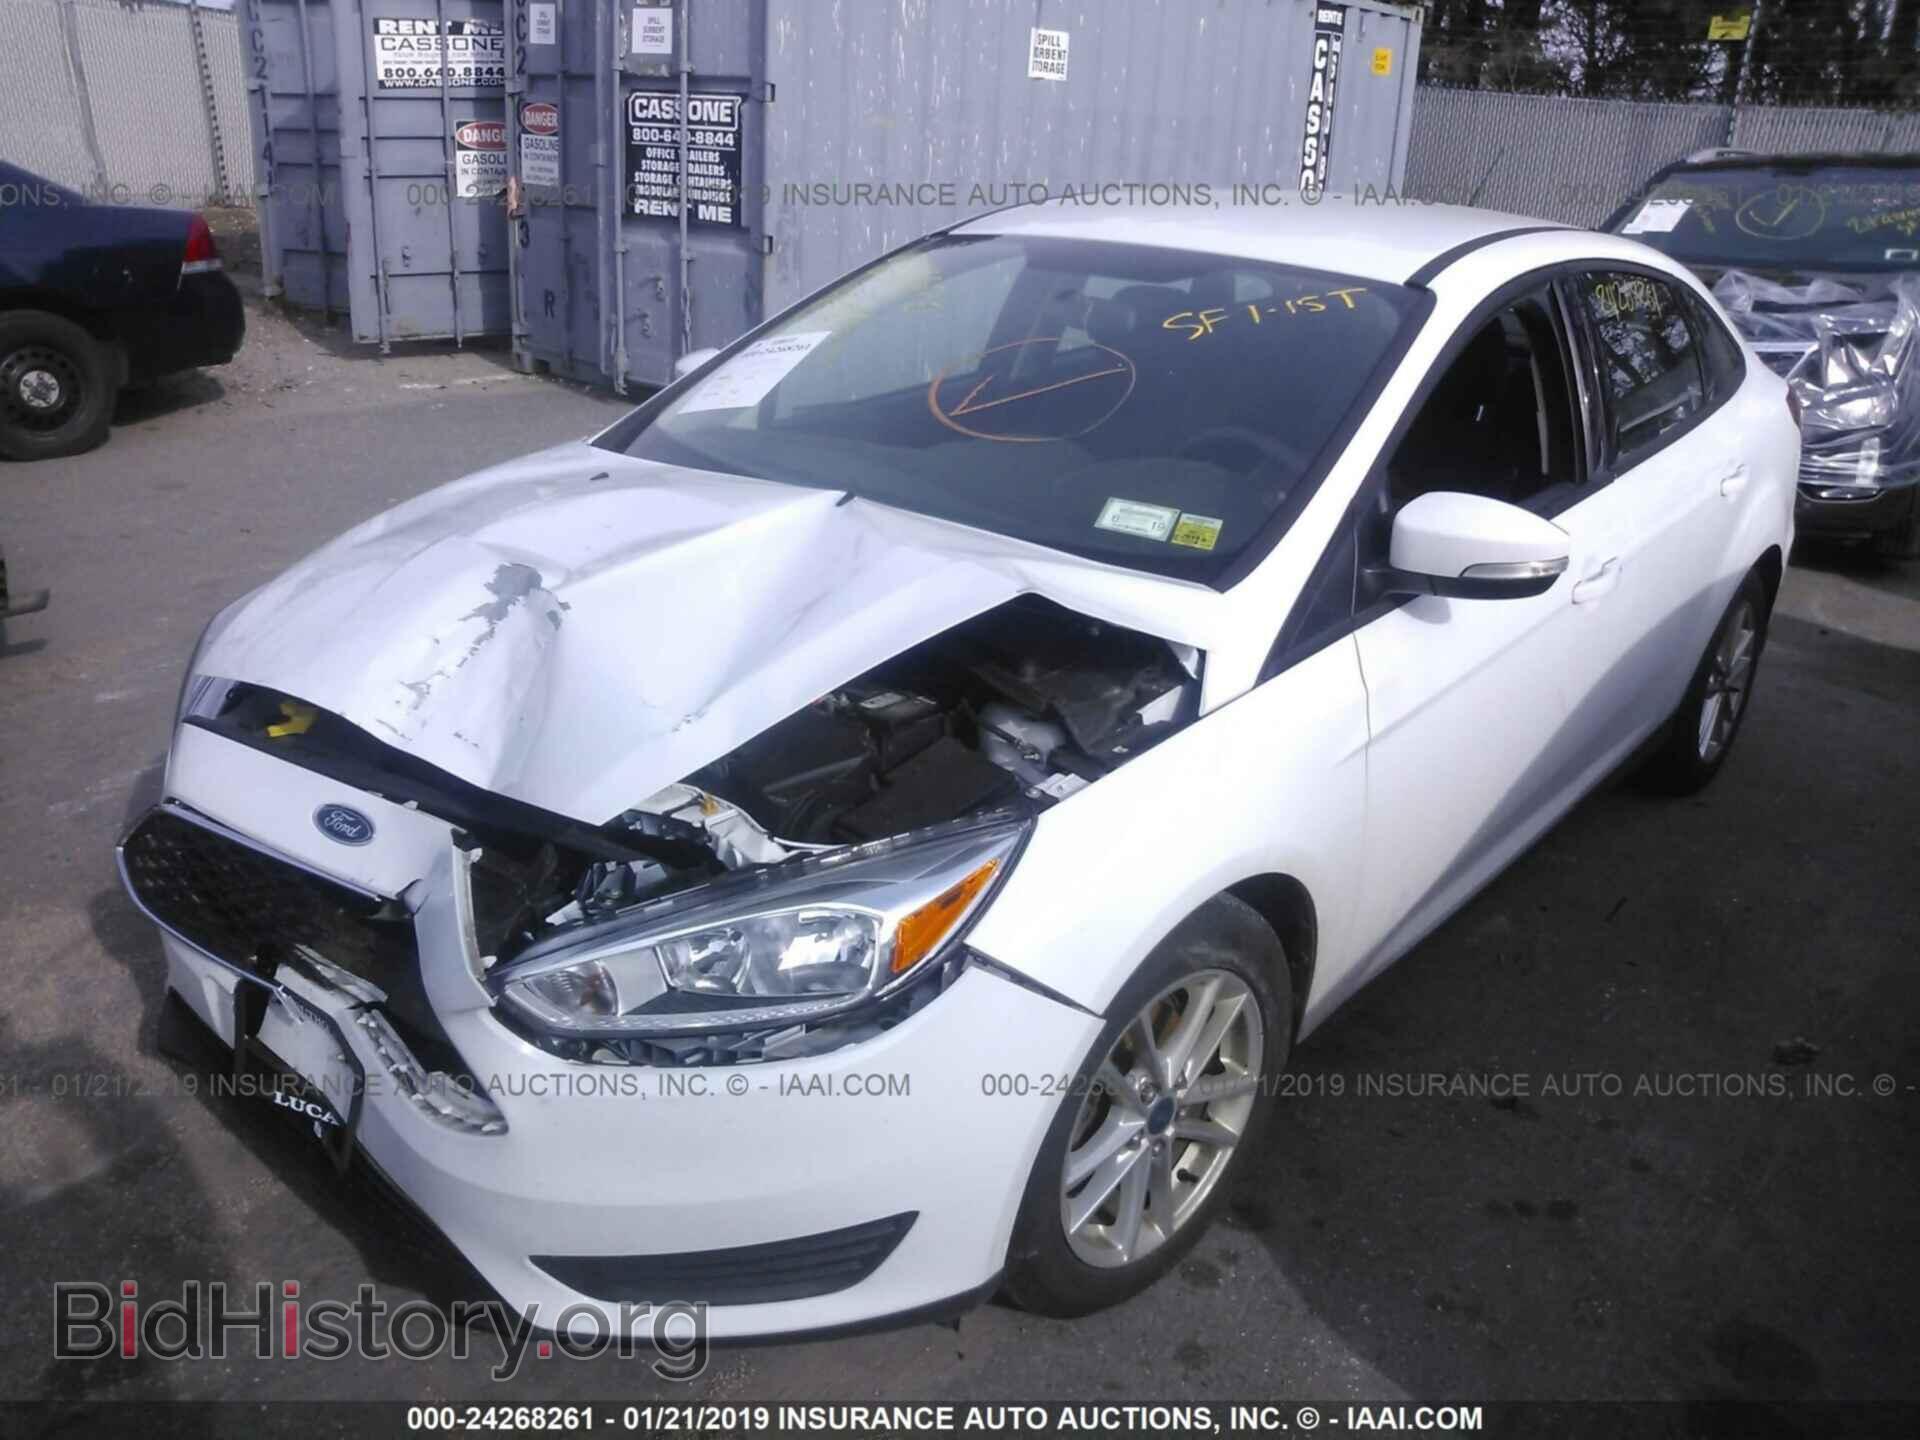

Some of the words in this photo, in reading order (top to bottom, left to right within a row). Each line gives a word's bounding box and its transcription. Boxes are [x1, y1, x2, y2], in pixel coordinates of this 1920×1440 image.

[381, 37, 504, 51] CASSONE
[1038, 33, 1061, 47] SPILL
[1034, 47, 1067, 60] ORBENT
[384, 67, 505, 78] 800.640.8844
[1033, 60, 1065, 75] TORAGE
[634, 98, 733, 122] CASSONE
[524, 111, 559, 127] DANGER
[632, 128, 735, 146] 800-640-8844
[646, 147, 675, 159] OFFICE
[641, 160, 680, 172] STORAGE
[687, 163, 725, 176] RAILERS
[634, 172, 673, 184] STORAGE
[698, 204, 732, 223] ME
[1162, 308, 1229, 340] SF
[324, 809, 362, 838] Ford
